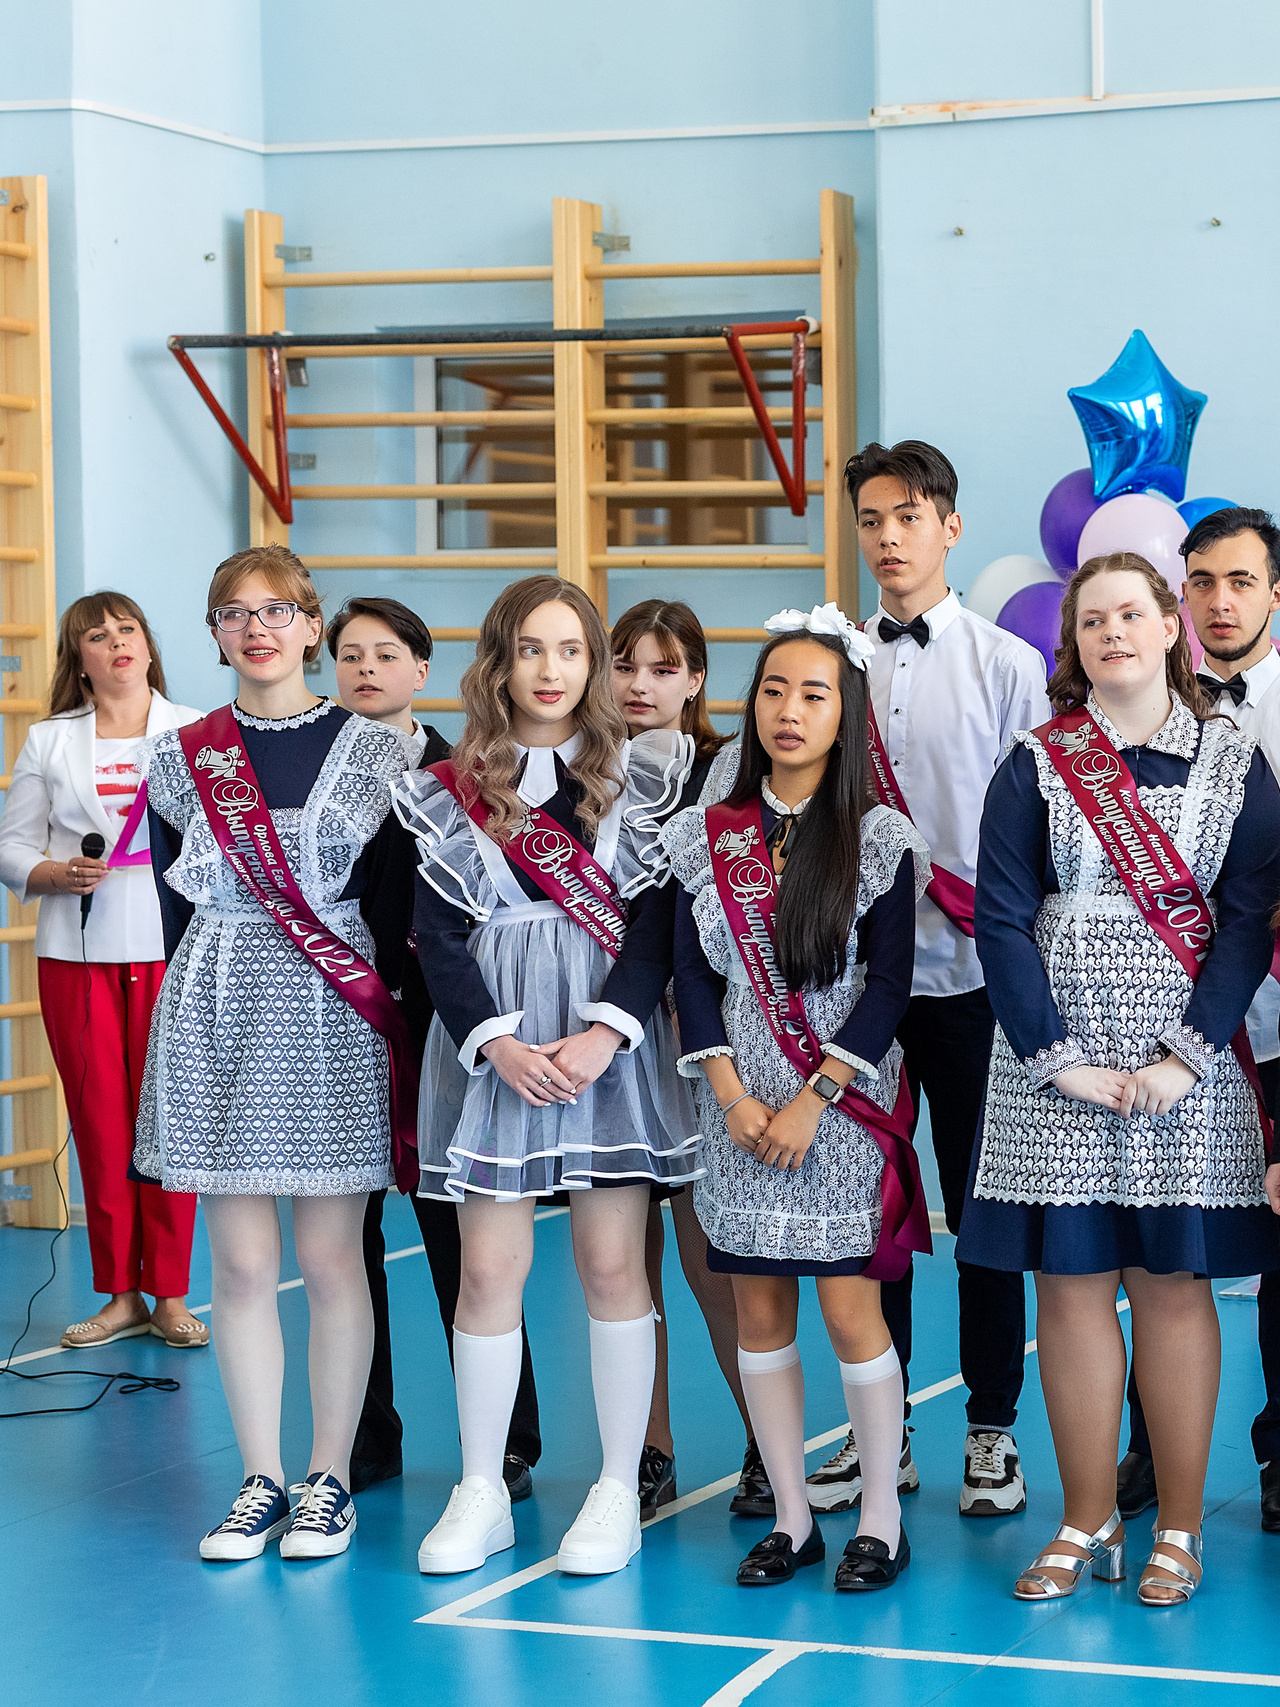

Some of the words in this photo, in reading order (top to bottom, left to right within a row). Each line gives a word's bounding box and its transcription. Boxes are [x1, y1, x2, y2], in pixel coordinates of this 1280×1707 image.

[870, 750, 891, 789] Азатов
[1071, 748, 1166, 891] Выпускница
[1118, 788, 1150, 833] Корбань
[1147, 833, 1182, 881] Наталья
[253, 824, 278, 866] Орлова
[271, 868, 288, 889] Ева
[1097, 824, 1116, 844] МБОУ
[1109, 844, 1125, 861] СОШ
[211, 777, 296, 918] Выпускница
[285, 918, 369, 984] 2021
[229, 854, 247, 874] МБОУ
[581, 865, 612, 895] Плют
[570, 906, 591, 923] МБОУ
[586, 922, 604, 937] СОШ
[742, 944, 758, 965] МБОУ
[751, 965, 764, 982] СОШ
